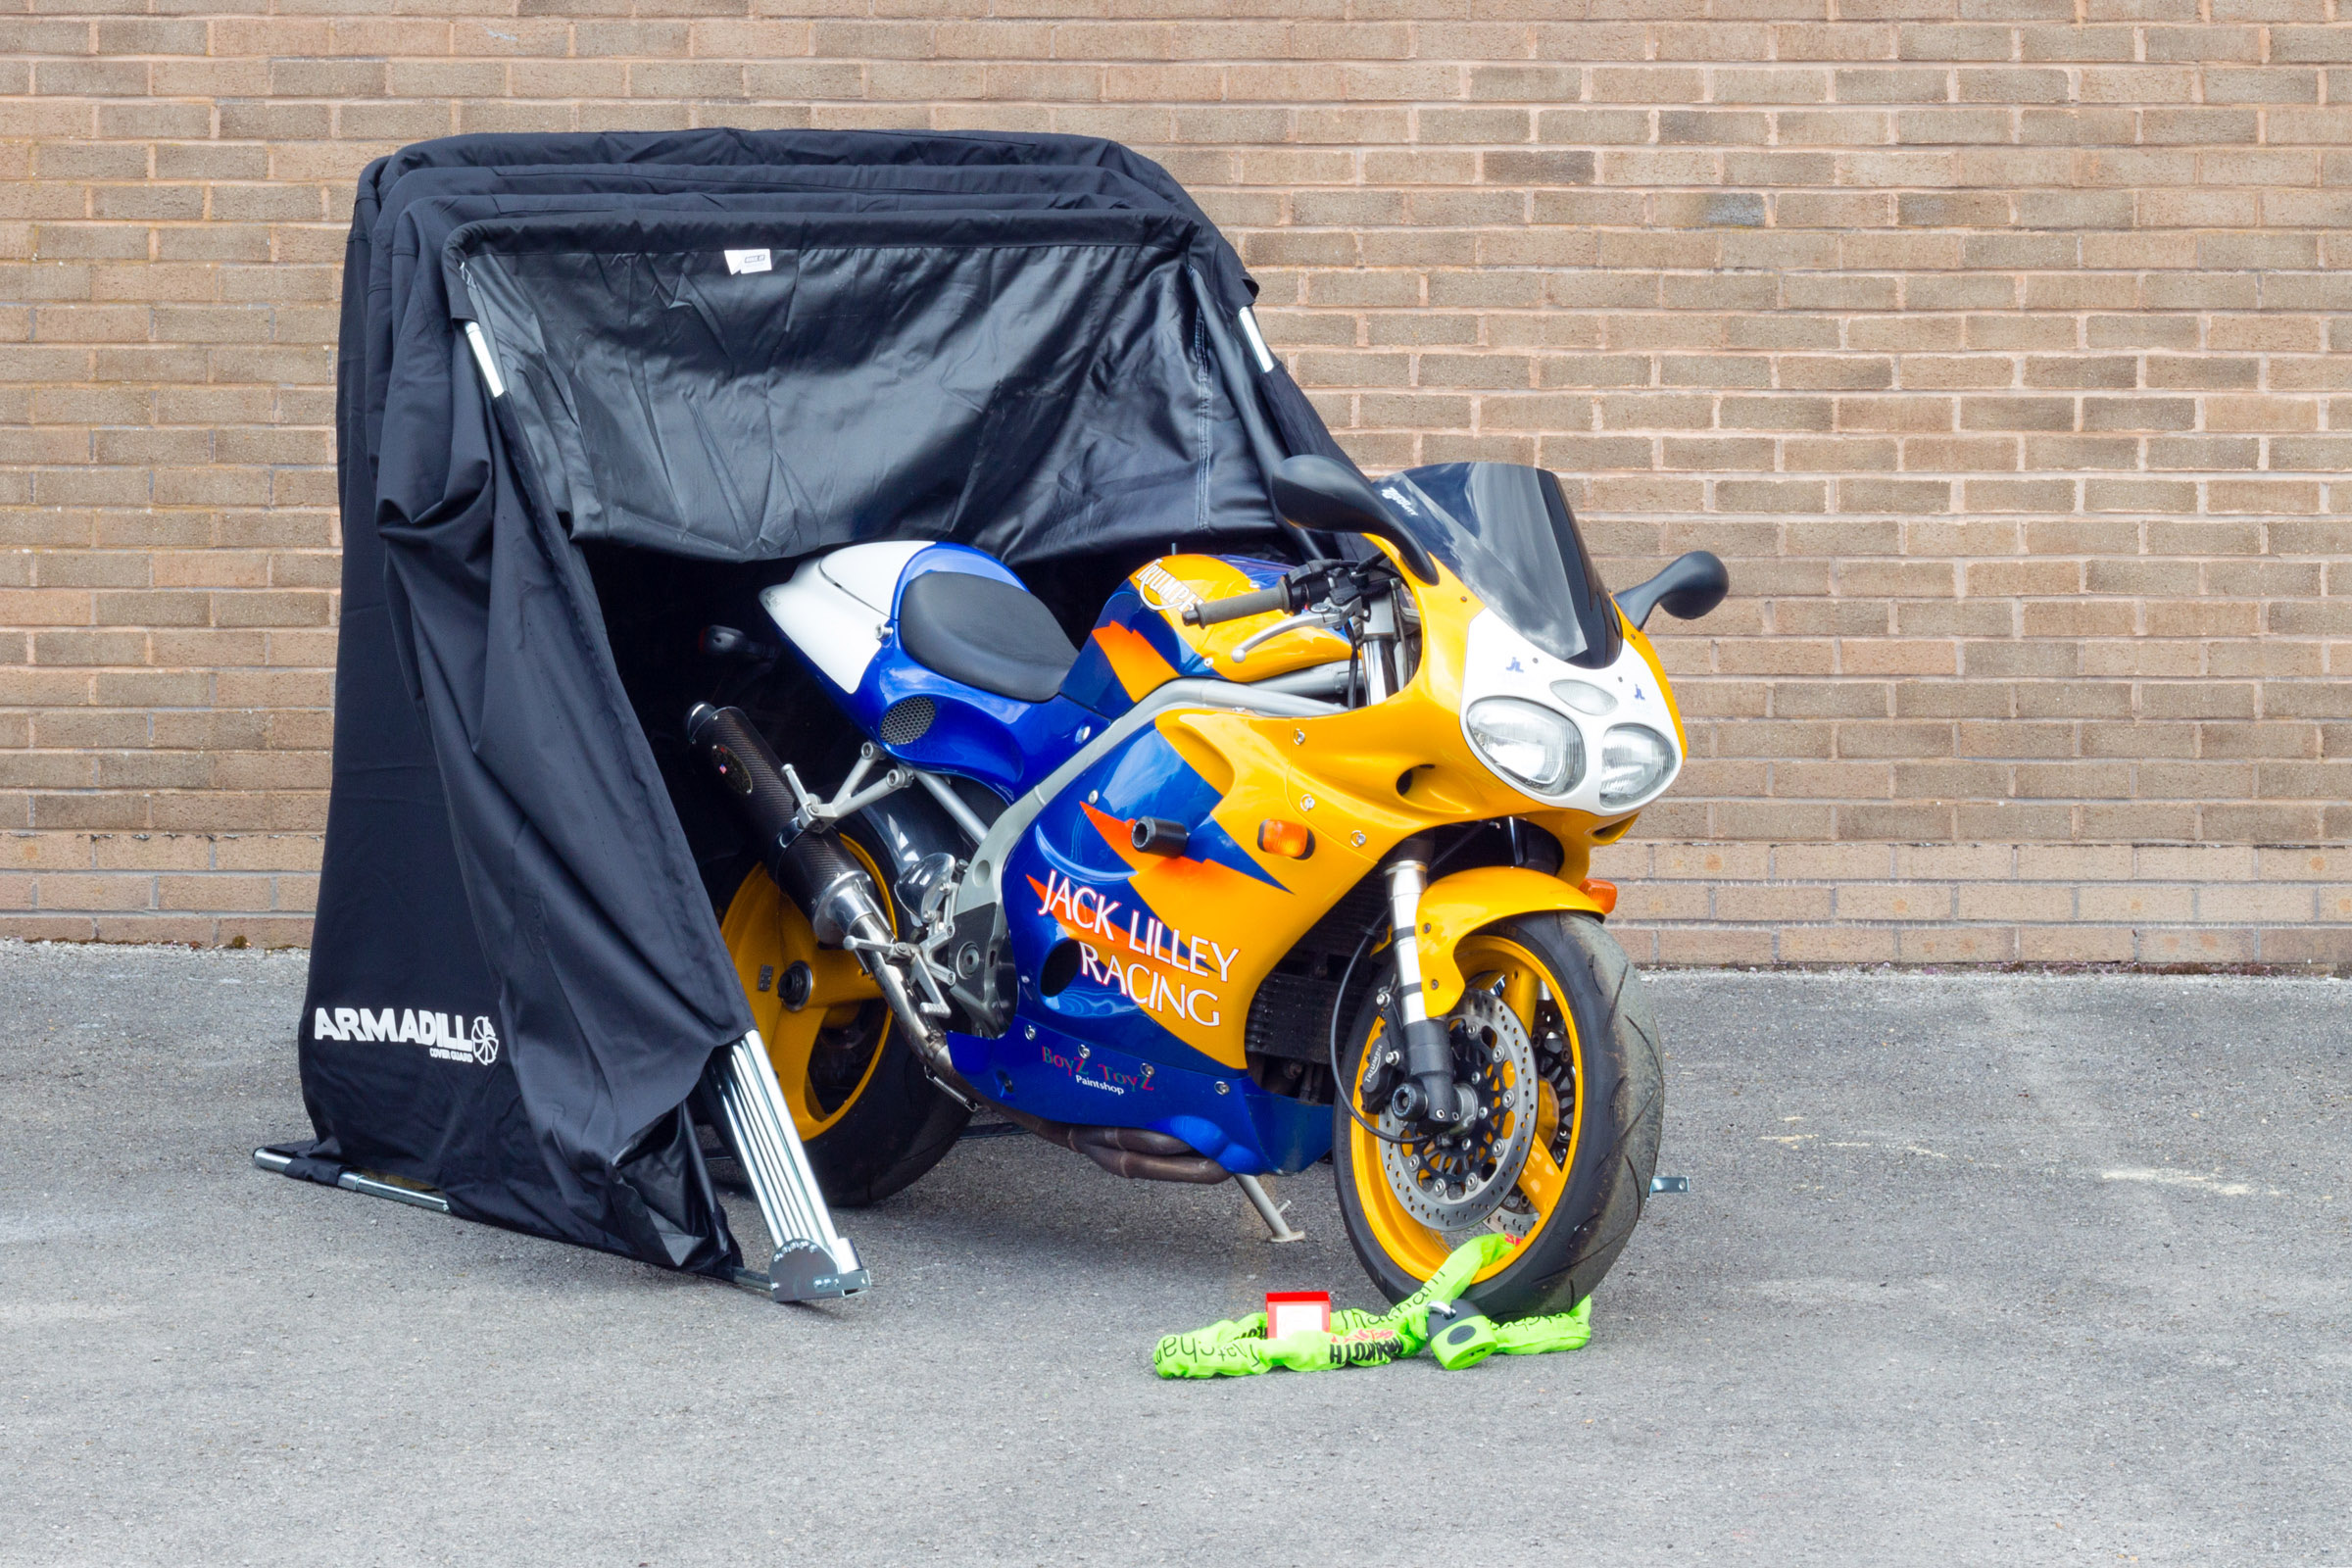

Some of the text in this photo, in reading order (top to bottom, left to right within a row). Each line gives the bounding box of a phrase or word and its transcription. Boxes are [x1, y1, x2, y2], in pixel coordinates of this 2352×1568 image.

[1038, 869, 1240, 982] JACK LILLEY
[1078, 941, 1221, 1027] RACING
[1075, 1074, 1124, 1096] Paintshop
[1364, 1044, 1383, 1083] TRIUMPH
